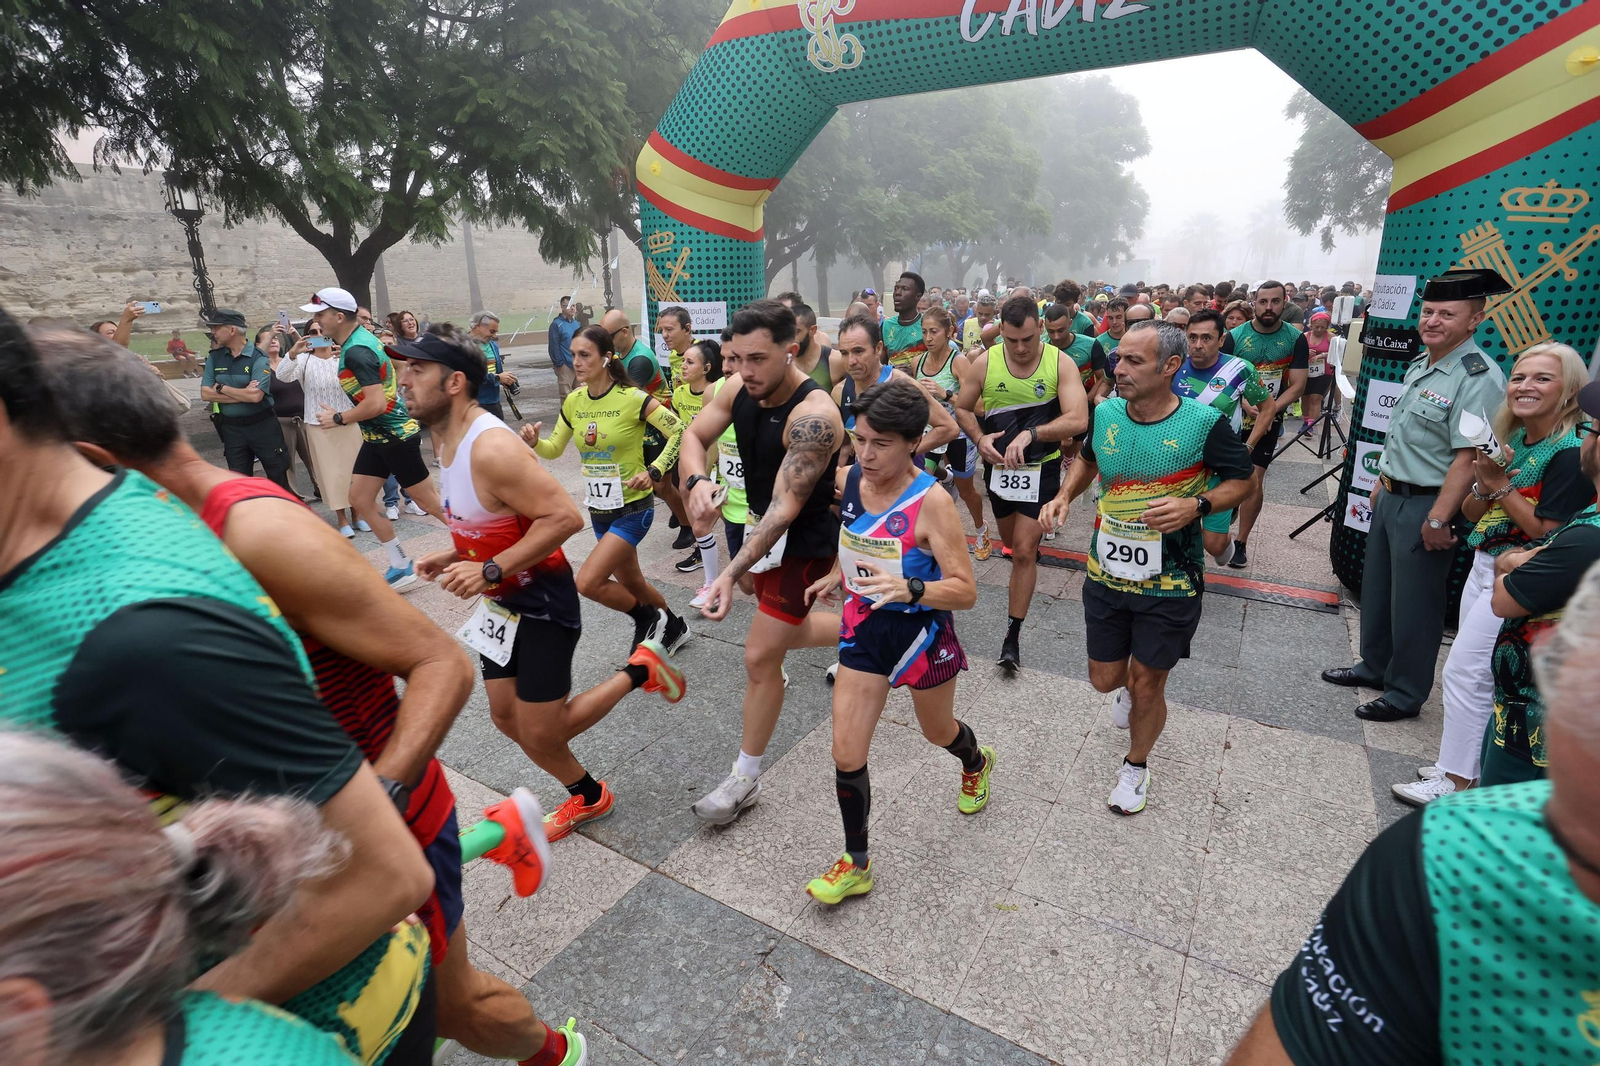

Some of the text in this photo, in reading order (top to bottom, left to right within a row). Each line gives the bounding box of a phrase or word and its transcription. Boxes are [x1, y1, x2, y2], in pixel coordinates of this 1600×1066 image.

[1370, 410, 1390, 420] Solera
[588, 482, 612, 498] 117
[1000, 474, 1031, 490] 383
[1106, 541, 1149, 566] 290
